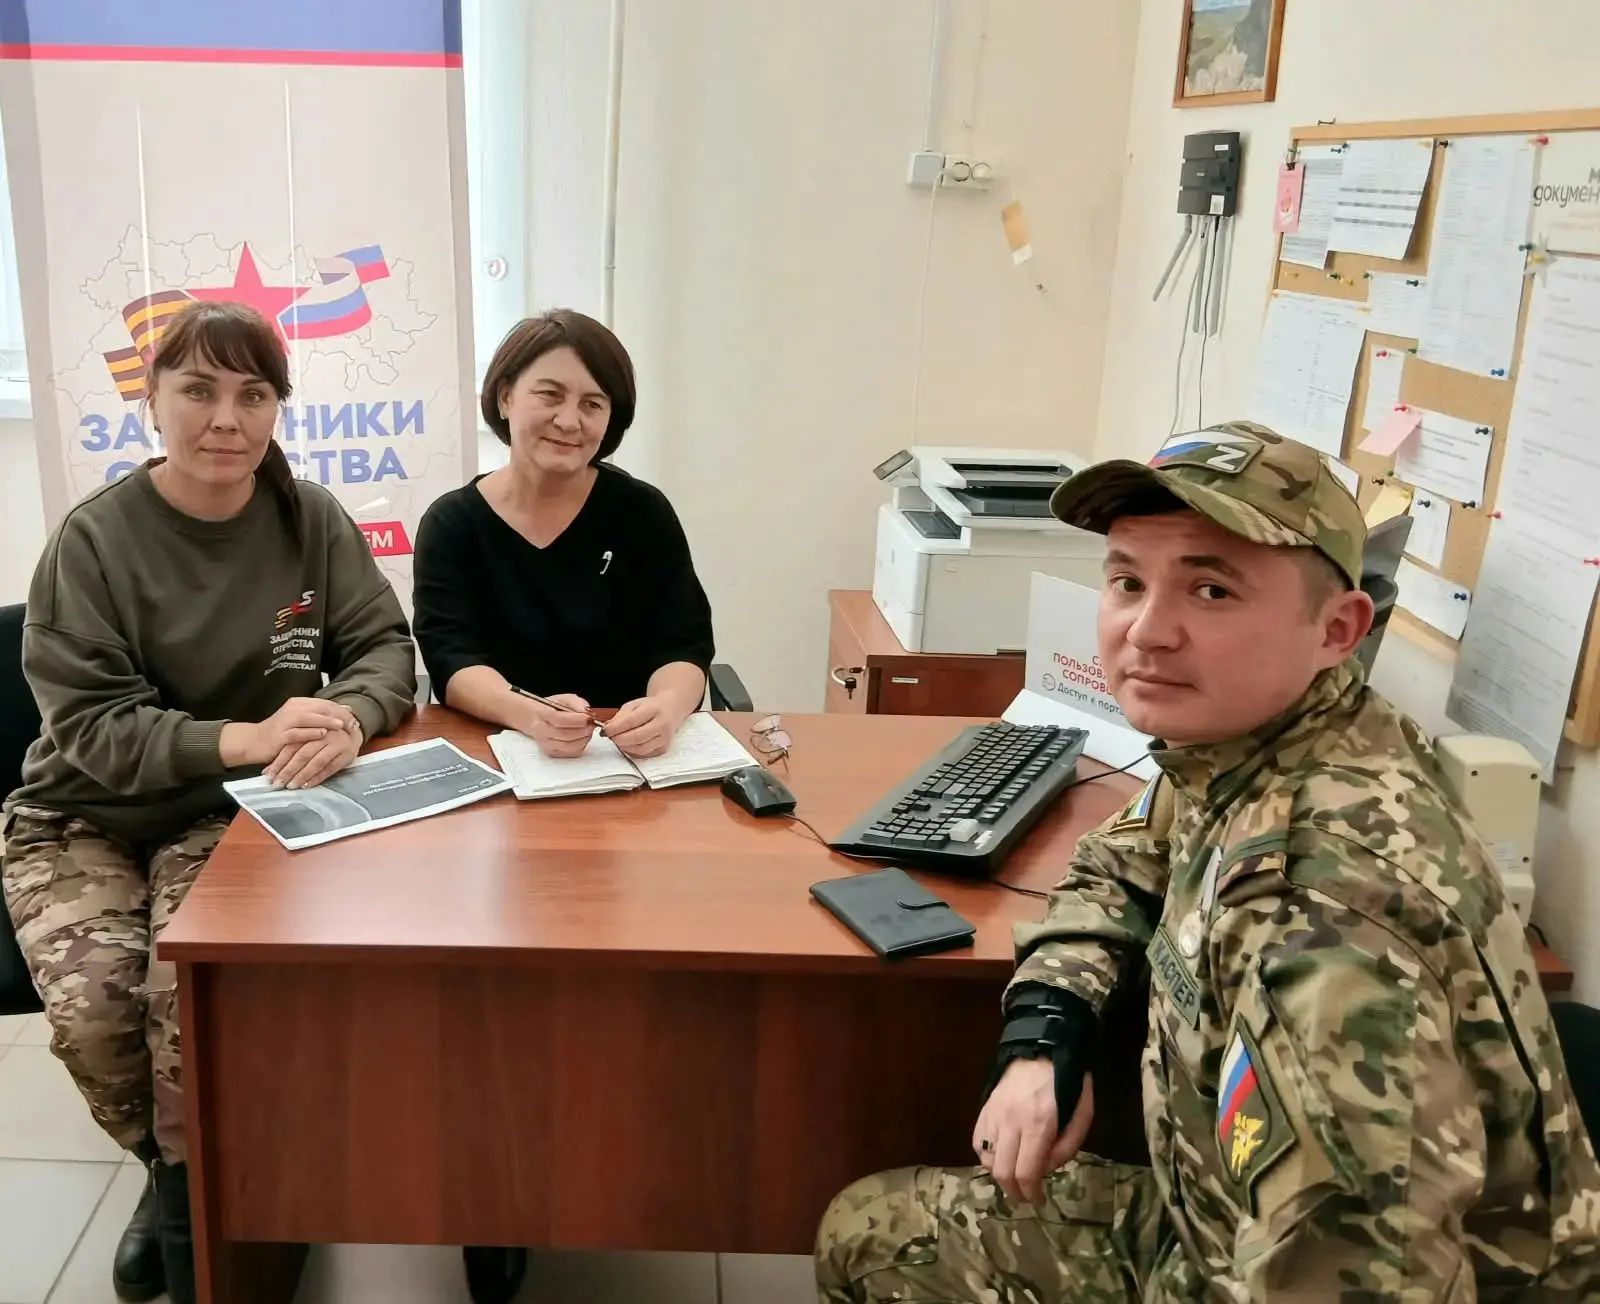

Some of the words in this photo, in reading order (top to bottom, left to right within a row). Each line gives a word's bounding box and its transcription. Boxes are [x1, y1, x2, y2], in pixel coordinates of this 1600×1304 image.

[80, 400, 425, 452] ЗАНИКИ
[1206, 444, 1248, 471] Z
[1057, 682, 1088, 701] Доступ
[1156, 939, 1196, 1009] КАСПЕР
